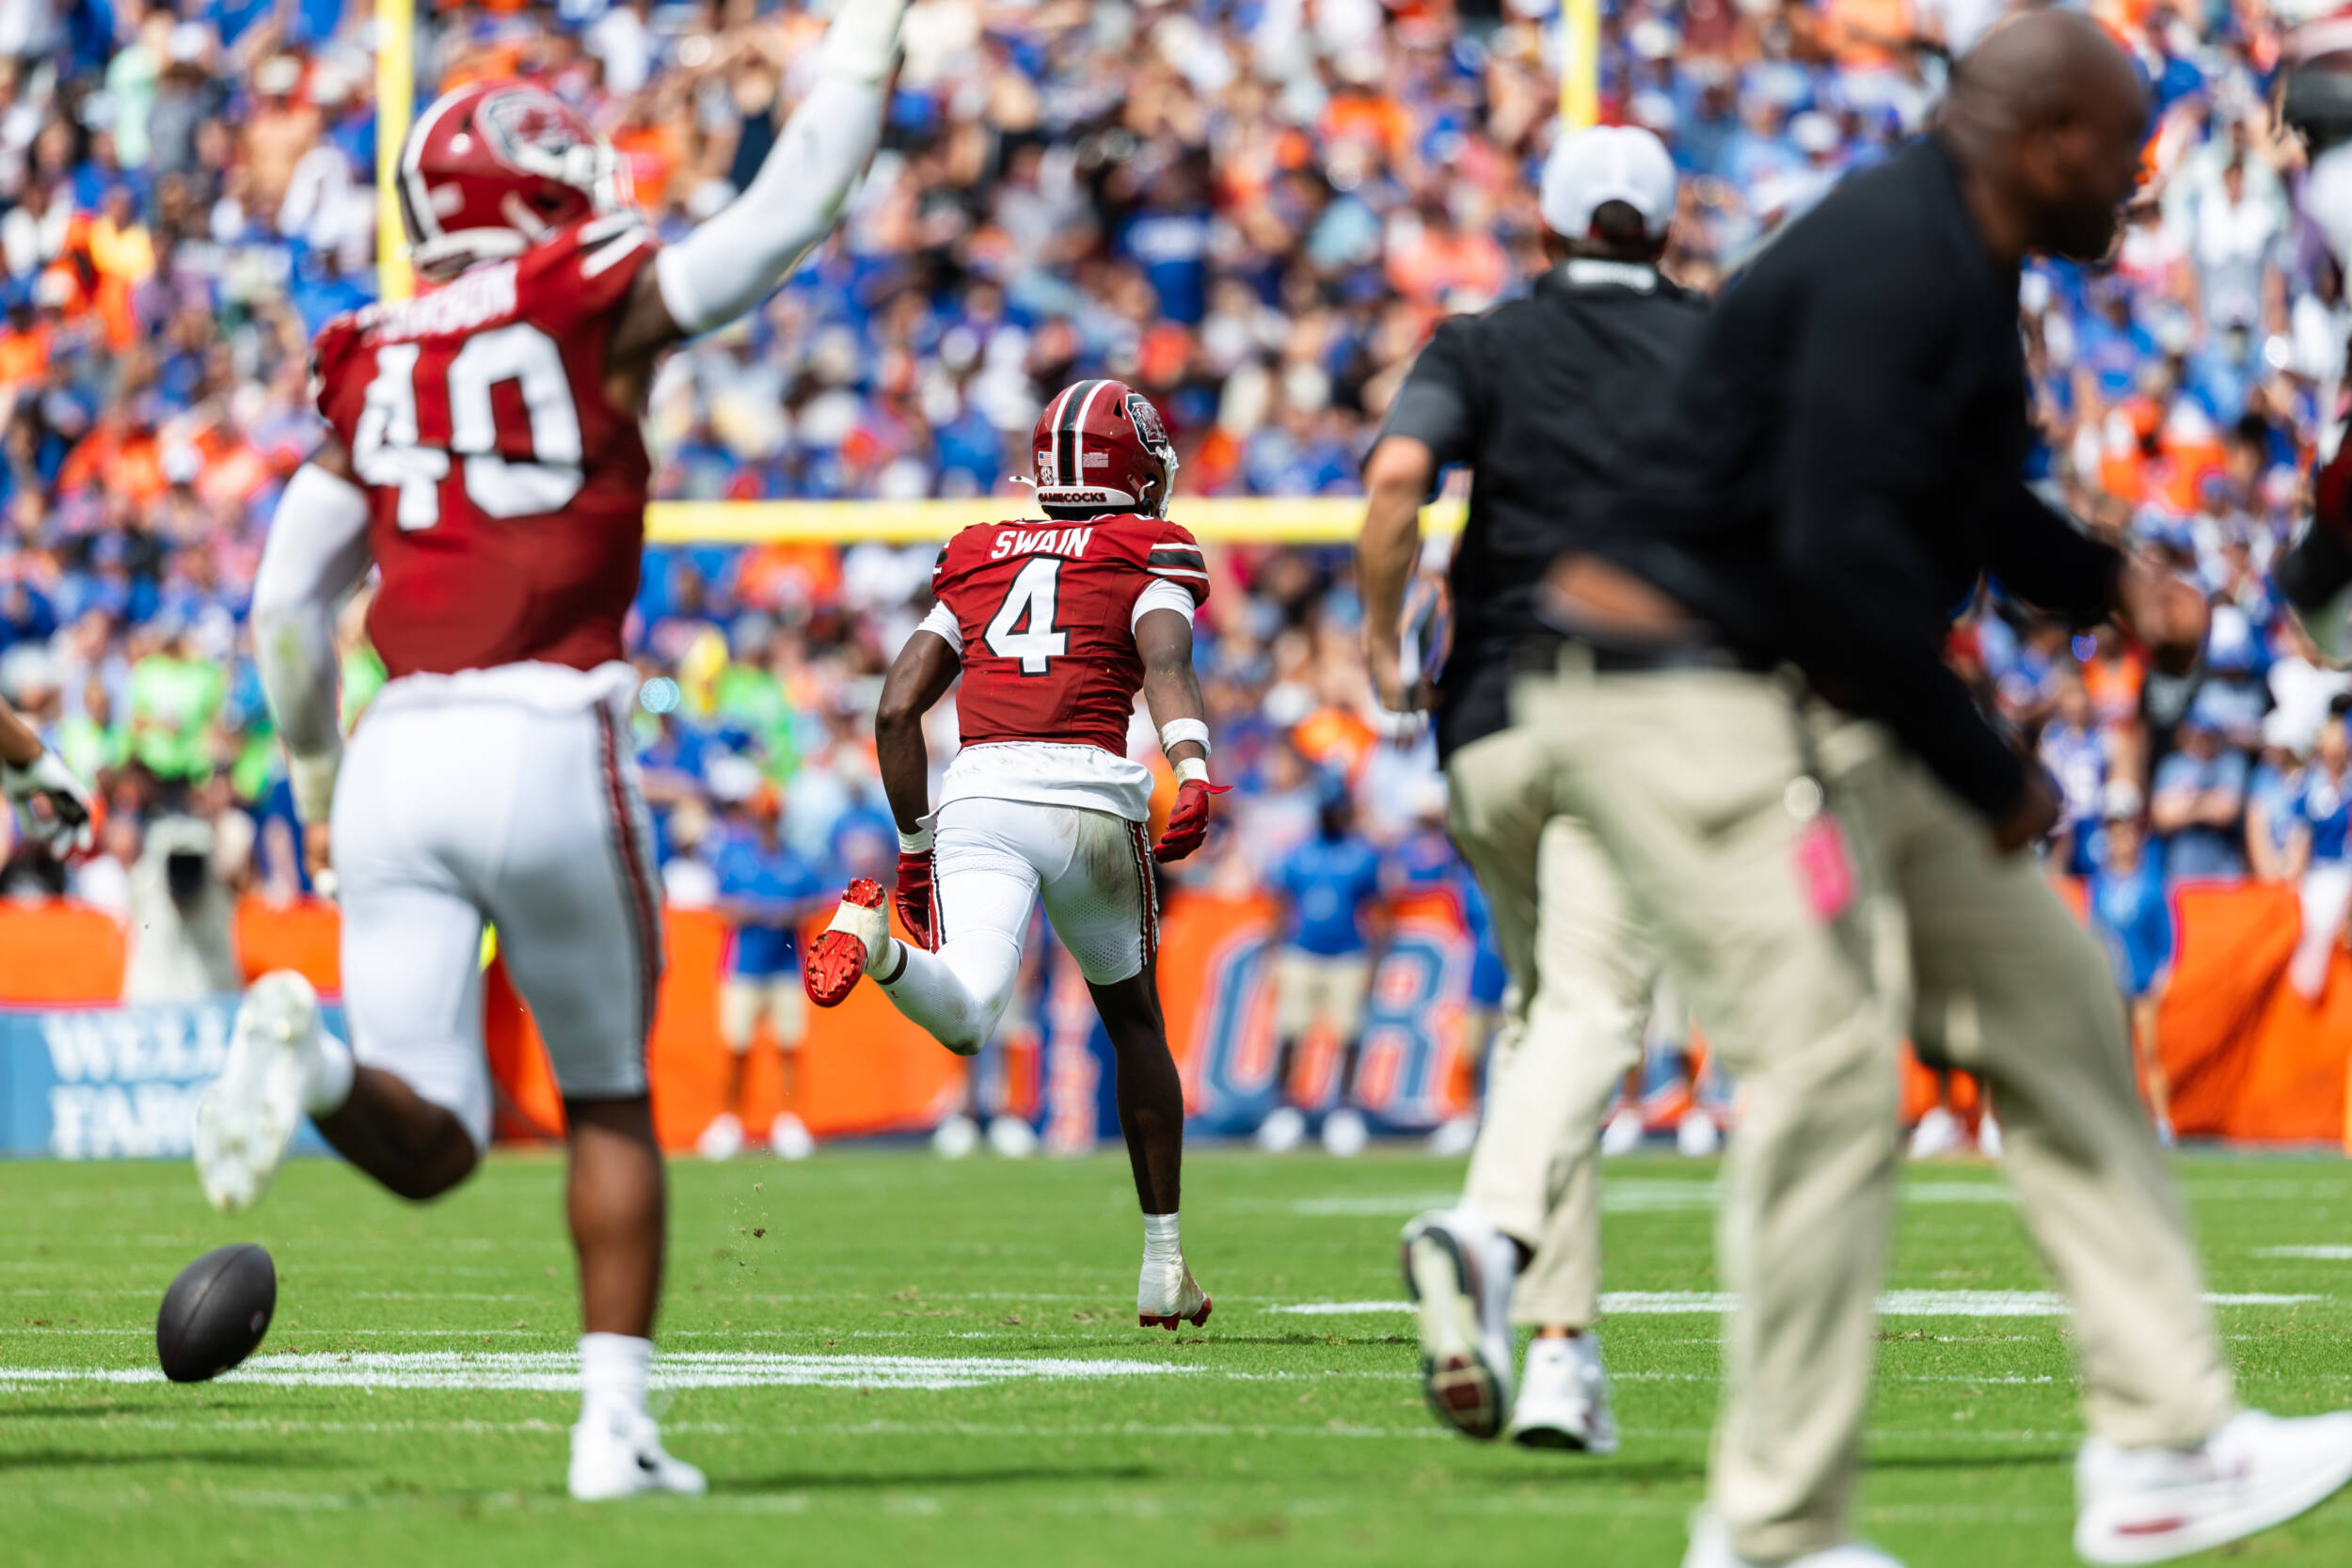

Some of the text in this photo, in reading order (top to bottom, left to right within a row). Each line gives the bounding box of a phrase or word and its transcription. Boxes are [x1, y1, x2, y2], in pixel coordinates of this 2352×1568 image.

[352, 321, 585, 531] 40
[1038, 492, 1107, 502] GAMECOCKS
[991, 527, 1094, 559] SWAIN
[981, 554, 1070, 676] 4
[40, 1009, 233, 1083] WELL
